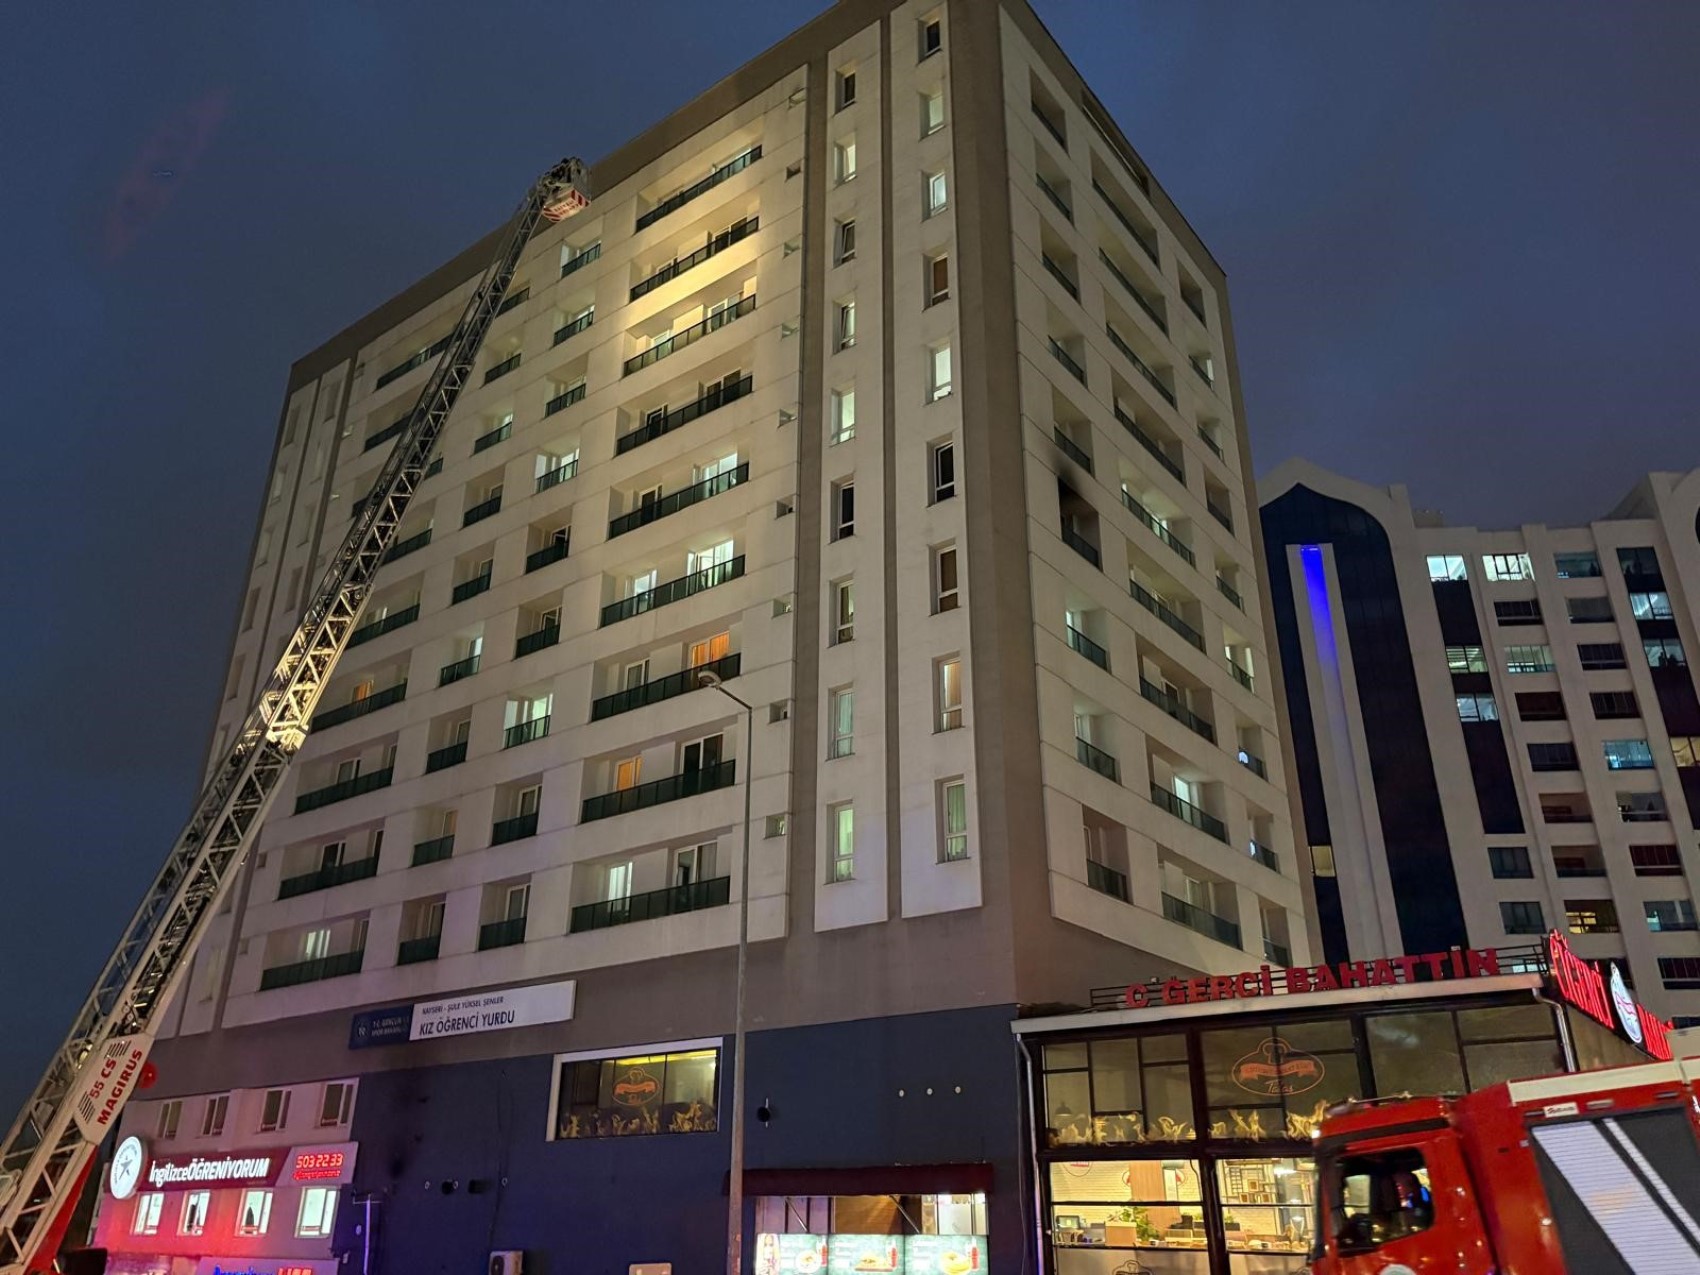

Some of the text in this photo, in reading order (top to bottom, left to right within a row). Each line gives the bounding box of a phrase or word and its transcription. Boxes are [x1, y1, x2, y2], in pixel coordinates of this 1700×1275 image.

[1286, 945, 1500, 994] BAHATTİN
[419, 1022, 434, 1035] KIZ
[436, 1011, 479, 1033] ÖĞRENCİ
[482, 1009, 515, 1027] YURDU
[89, 1058, 117, 1100] 55 CS
[96, 1049, 143, 1125] MAGIRUS
[296, 1153, 343, 1168] 503 22 33
